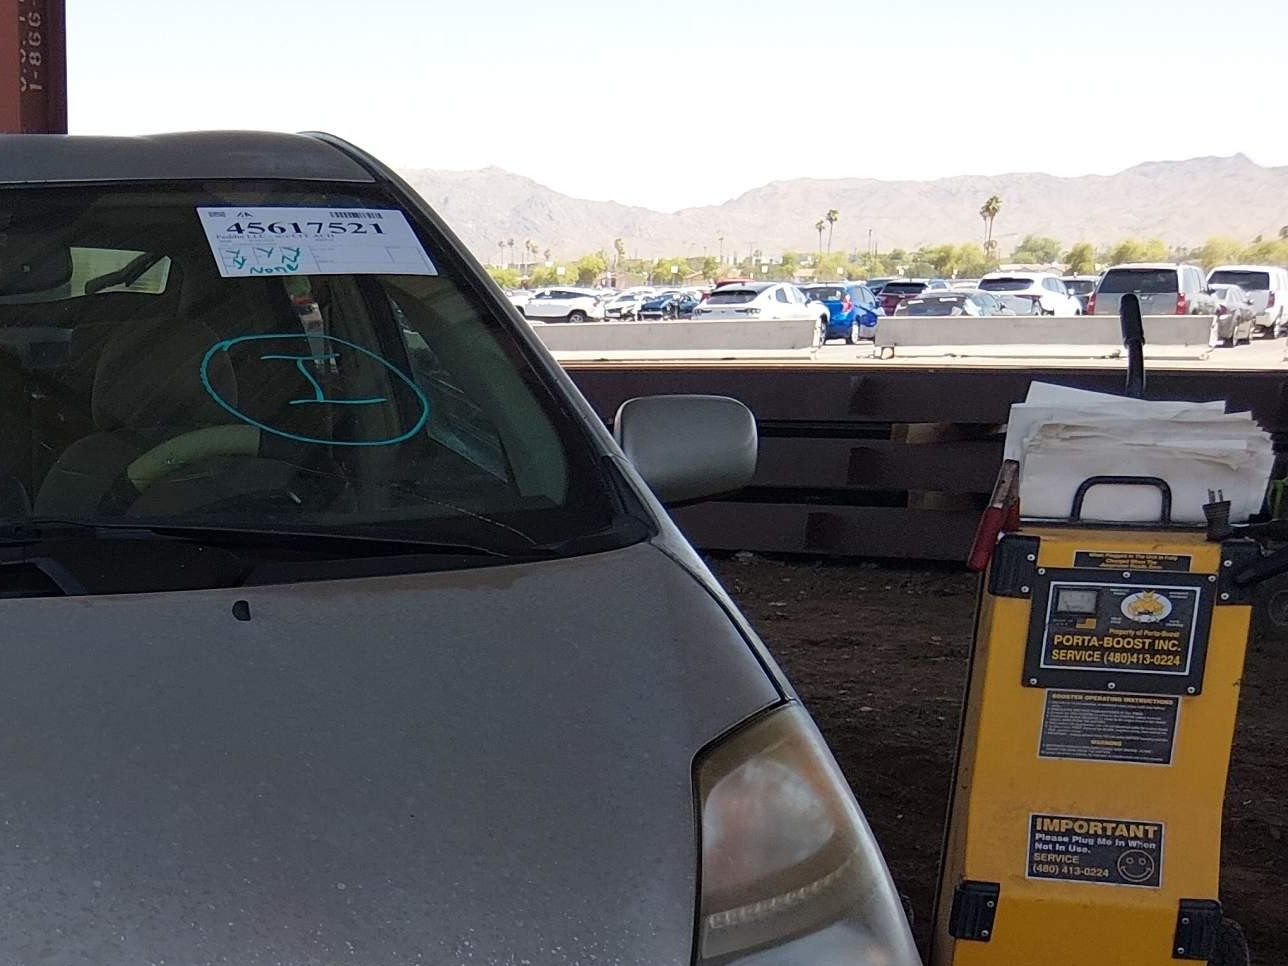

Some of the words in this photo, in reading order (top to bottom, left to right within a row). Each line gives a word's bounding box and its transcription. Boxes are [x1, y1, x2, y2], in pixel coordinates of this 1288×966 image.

[226, 222, 385, 235] 45617521
[1054, 634, 1152, 649] PORTA-BOOST
[1154, 640, 1182, 651] INC.
[1051, 649, 1101, 662] SERVICE
[1103, 651, 1181, 666] (480)413-0224
[1036, 818, 1158, 838] IMPORTANT
[1034, 842, 1053, 850] Not
[1055, 843, 1066, 852] In
[1068, 844, 1091, 853] Use.
[1035, 833, 1069, 842] Please
[1071, 836, 1094, 845] Plug
[1097, 838, 1112, 846] Me
[1115, 839, 1125, 847] In
[1128, 840, 1156, 849] When
[1033, 852, 1080, 864] SERVICE
[1032, 863, 1059, 875] (480)
[1061, 866, 1109, 877] 413-0224
